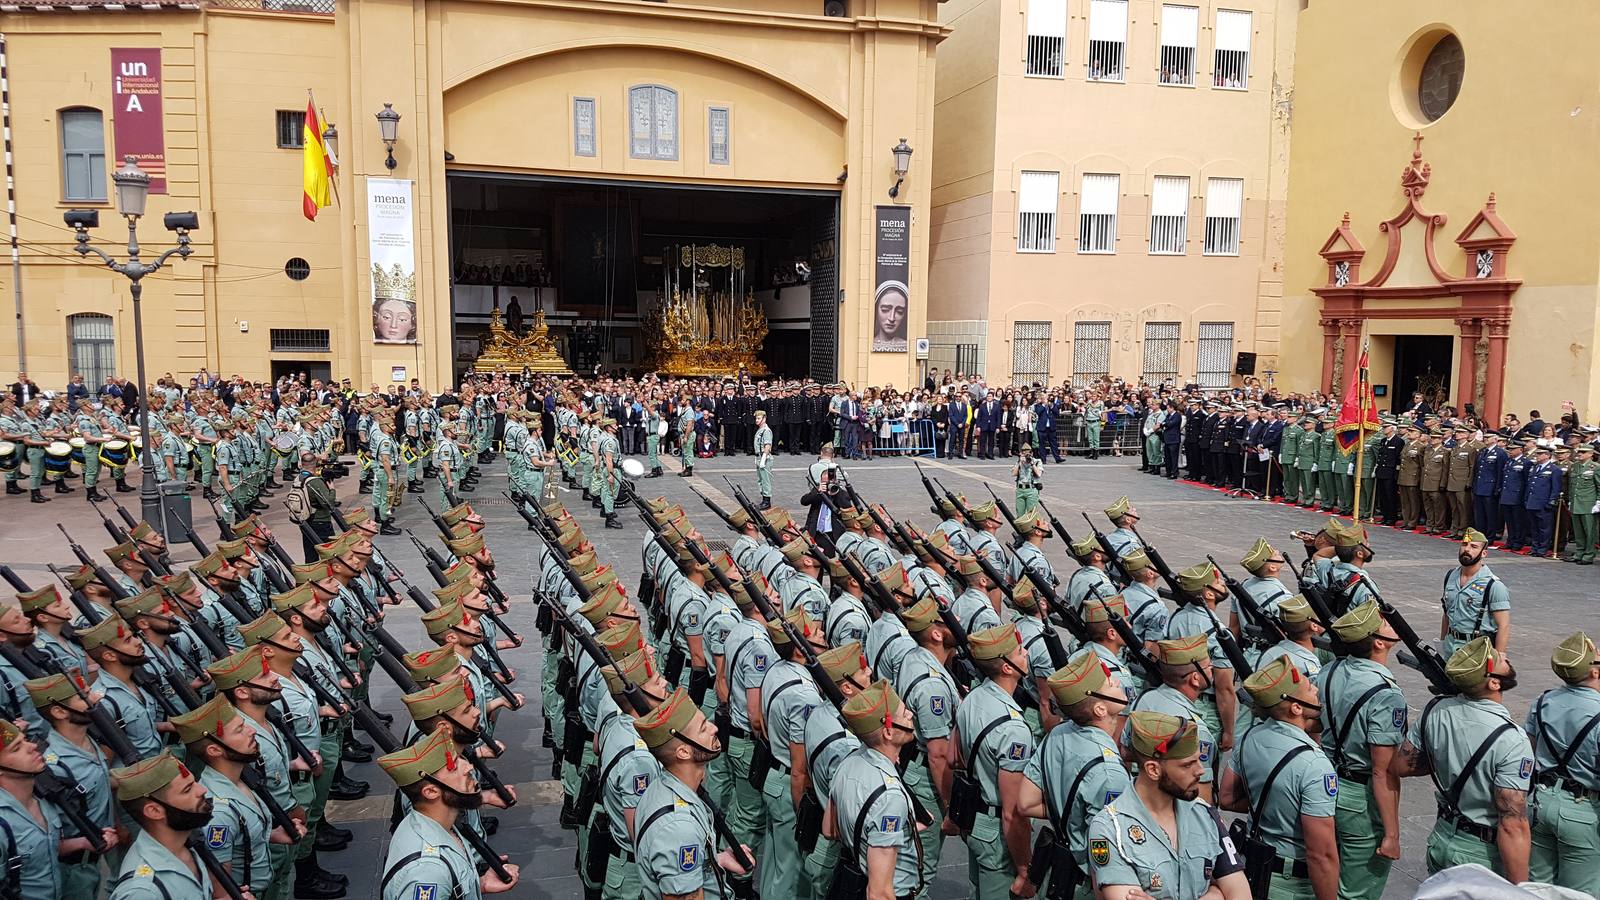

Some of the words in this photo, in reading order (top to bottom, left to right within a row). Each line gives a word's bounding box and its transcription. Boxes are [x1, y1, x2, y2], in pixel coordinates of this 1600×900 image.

[121, 62, 147, 76] un
[126, 94, 143, 112] A
[374, 194, 406, 204] mena
[880, 219, 905, 228] mena
